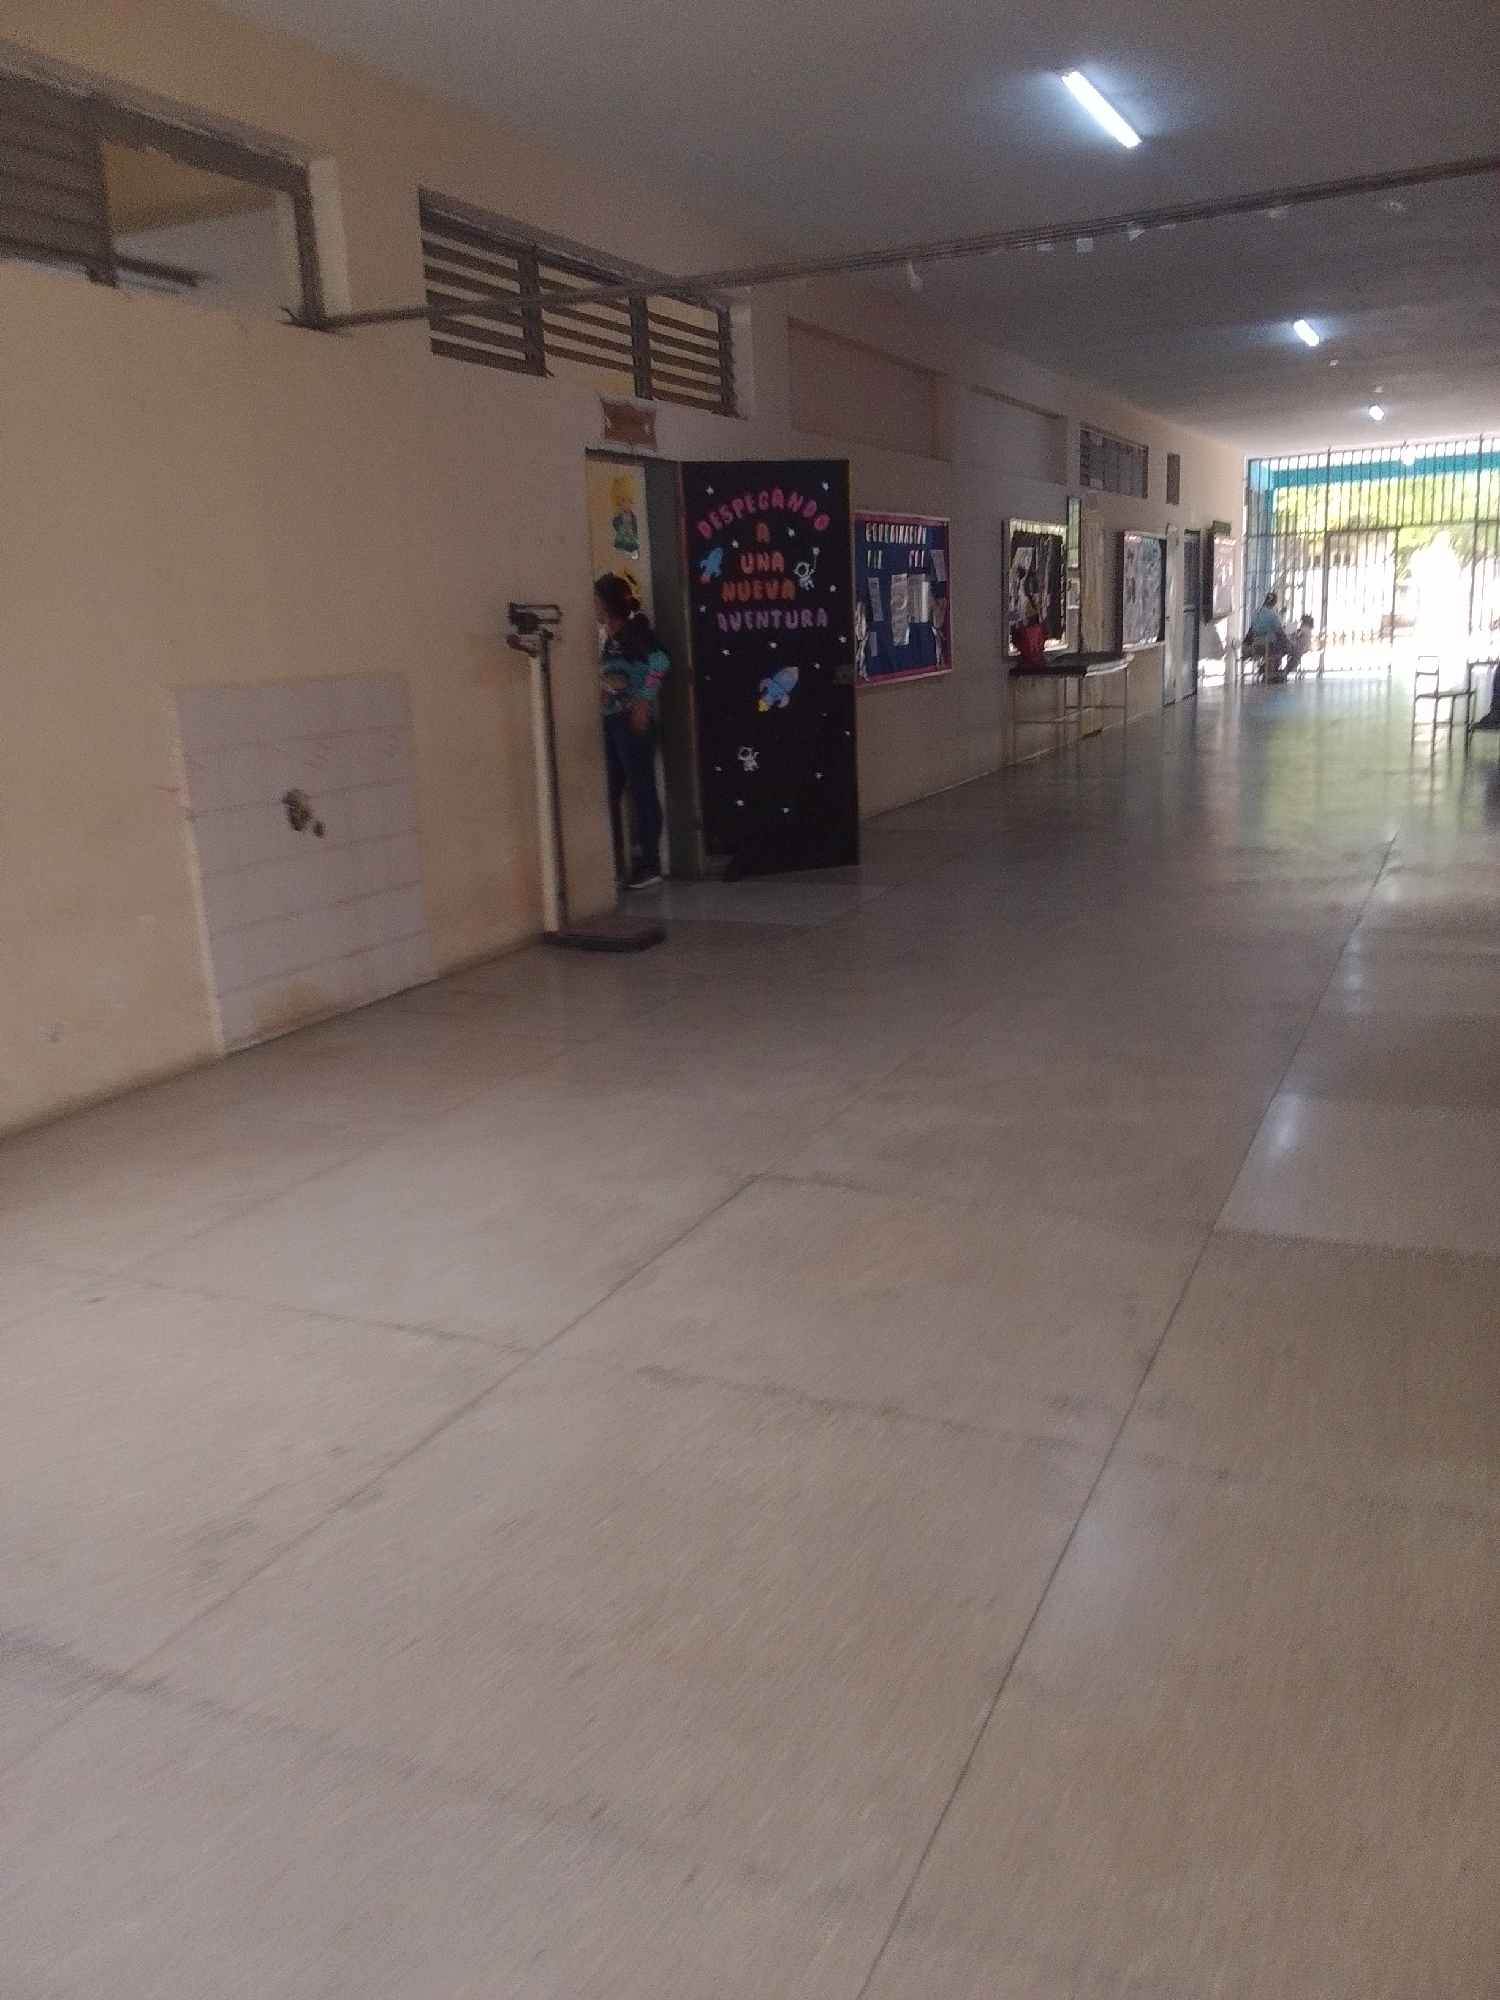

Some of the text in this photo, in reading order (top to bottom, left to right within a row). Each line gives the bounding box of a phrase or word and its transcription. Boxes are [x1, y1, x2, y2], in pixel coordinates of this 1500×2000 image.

[756, 522, 770, 543] A
[741, 551, 785, 574] UNA
[722, 579, 796, 602] NUEVA
[717, 607, 828, 632] AVENTURA
